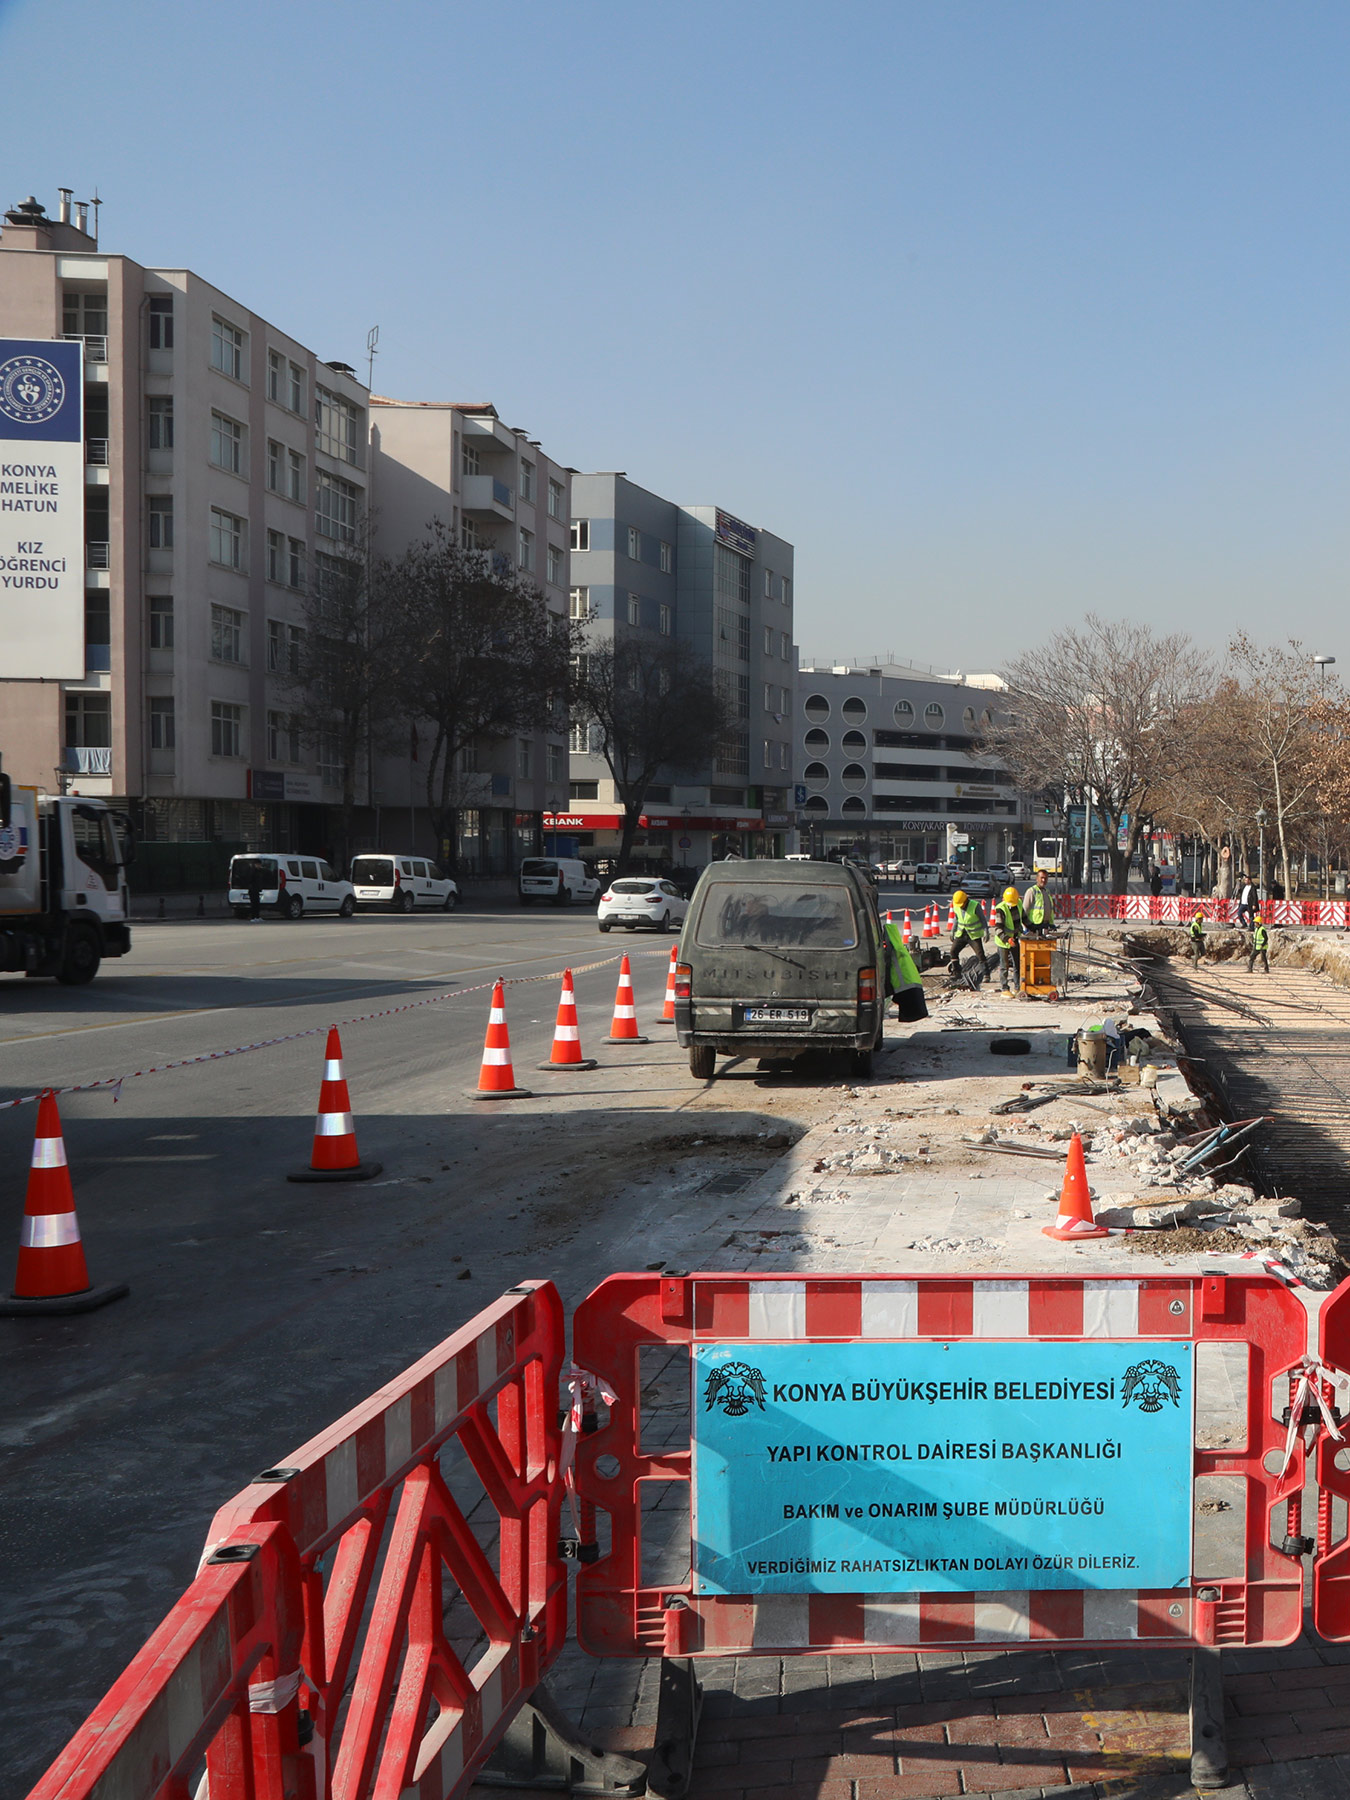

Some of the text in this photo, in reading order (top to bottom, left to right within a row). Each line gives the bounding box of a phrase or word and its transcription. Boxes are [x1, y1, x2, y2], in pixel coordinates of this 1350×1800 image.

[2, 464, 57, 478] KONYA
[0, 479, 59, 495] MELİKE
[1, 499, 58, 513] HATUN
[17, 541, 43, 554] KIZ
[0, 556, 66, 572] ÖĞRENCİ
[2, 576, 59, 589] YURDU
[543, 818, 584, 826] KBANK
[902, 821, 948, 830] KONYAKAR
[703, 968, 851, 980] MITSUBISHI
[751, 1010, 807, 1020] 26 ER 519
[773, 1378, 1114, 1404] KONYA BÜYÜKŞEHİR BELEDİYESİ
[766, 1439, 1121, 1463] YAPI KONTROL DAİRESİ BAŞKANLIĞI
[783, 1497, 1104, 1520] BAKIM ve ONARIM ŞUBE MÜDÜRLÜĞÜ
[747, 1554, 1139, 1574] VERDİĞİMİZ RAHATSIZLIKTAN DOLAYI ÖZÜR DİLERİZ.
